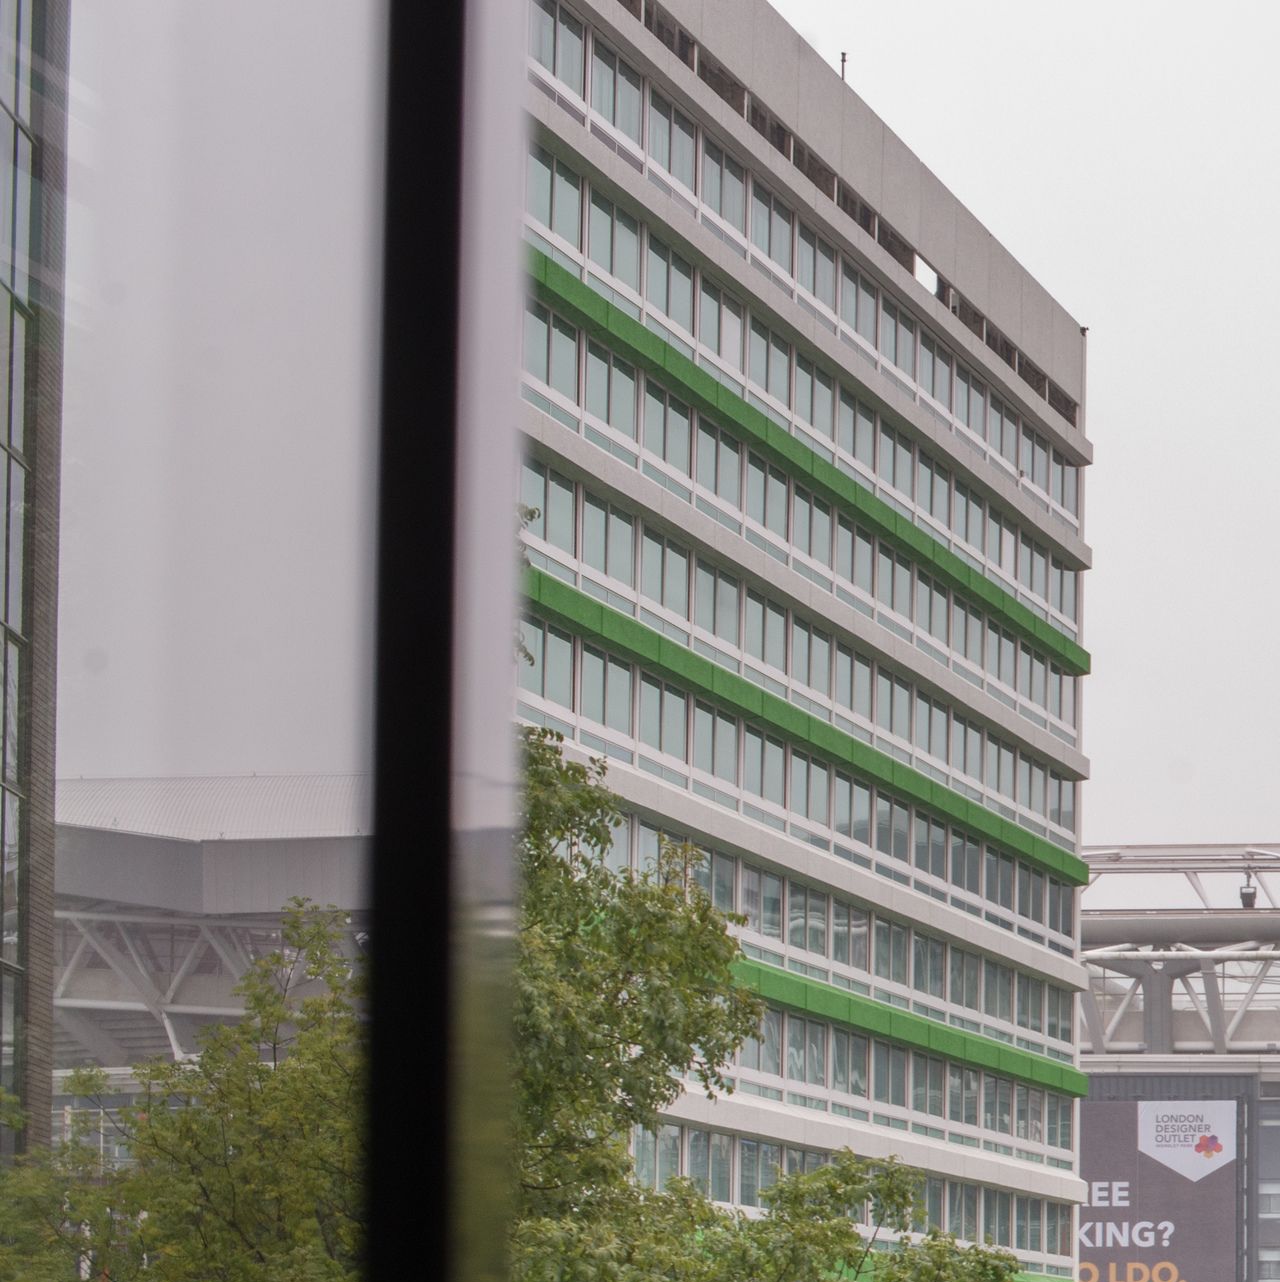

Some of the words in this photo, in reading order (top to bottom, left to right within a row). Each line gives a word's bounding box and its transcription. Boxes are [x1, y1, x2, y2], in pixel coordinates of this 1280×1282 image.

[1155, 1114, 1204, 1123] LONDON
[1155, 1124, 1211, 1133] DESIGNER
[1155, 1134, 1196, 1143] OUTLET
[1081, 1181, 1130, 1207] EE
